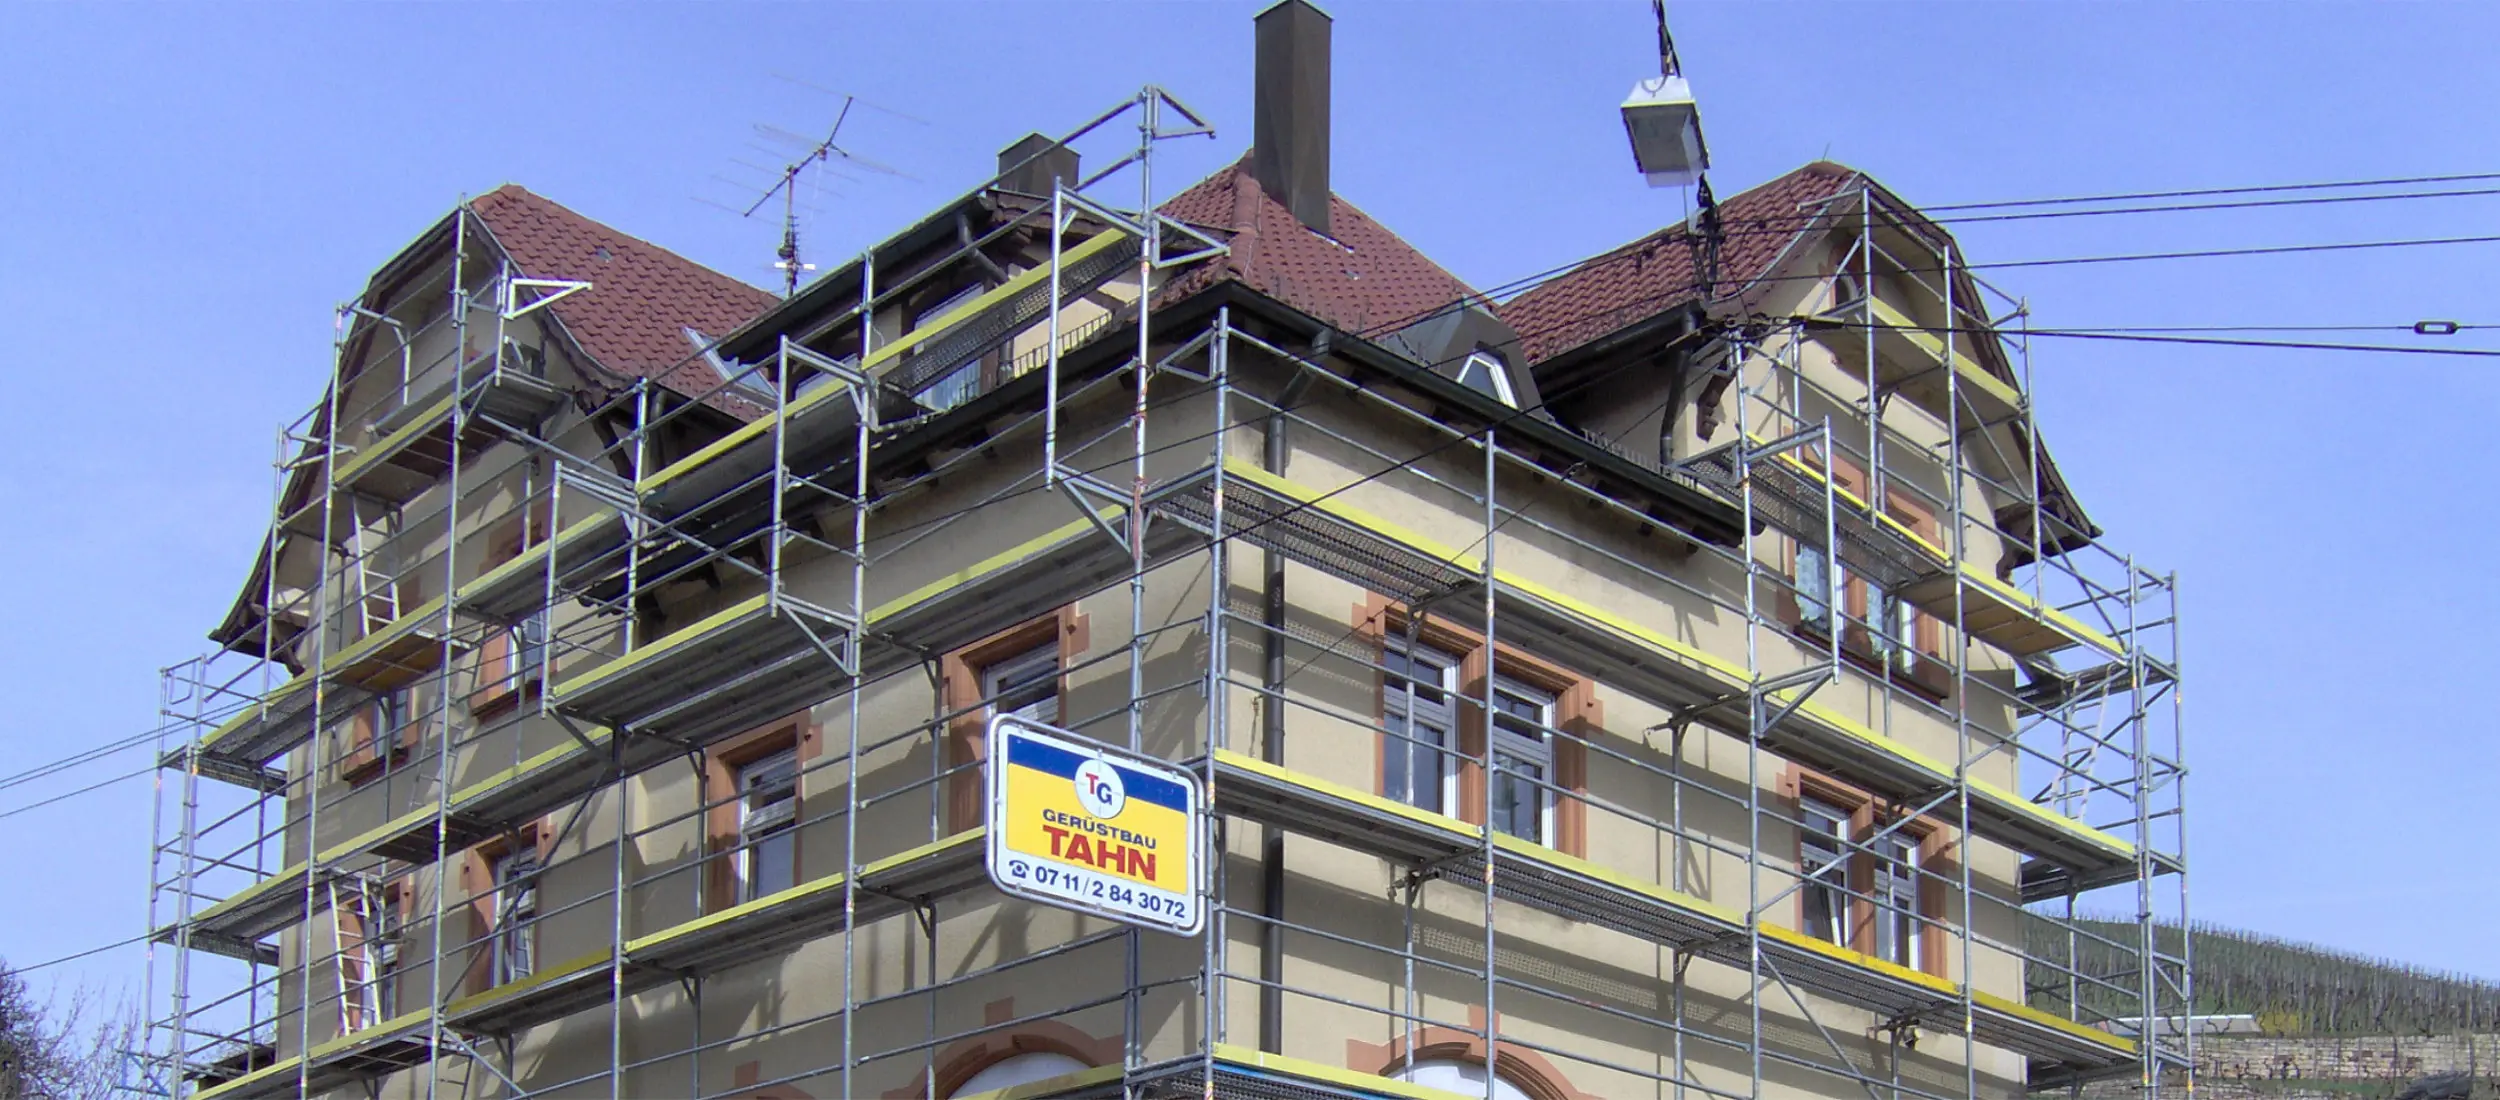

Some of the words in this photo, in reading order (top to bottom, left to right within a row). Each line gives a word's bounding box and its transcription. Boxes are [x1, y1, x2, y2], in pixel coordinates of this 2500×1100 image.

[1086, 773, 1113, 805] TG
[1042, 808, 1157, 850] GERÜSTBAU
[1042, 825, 1156, 882] TAHN
